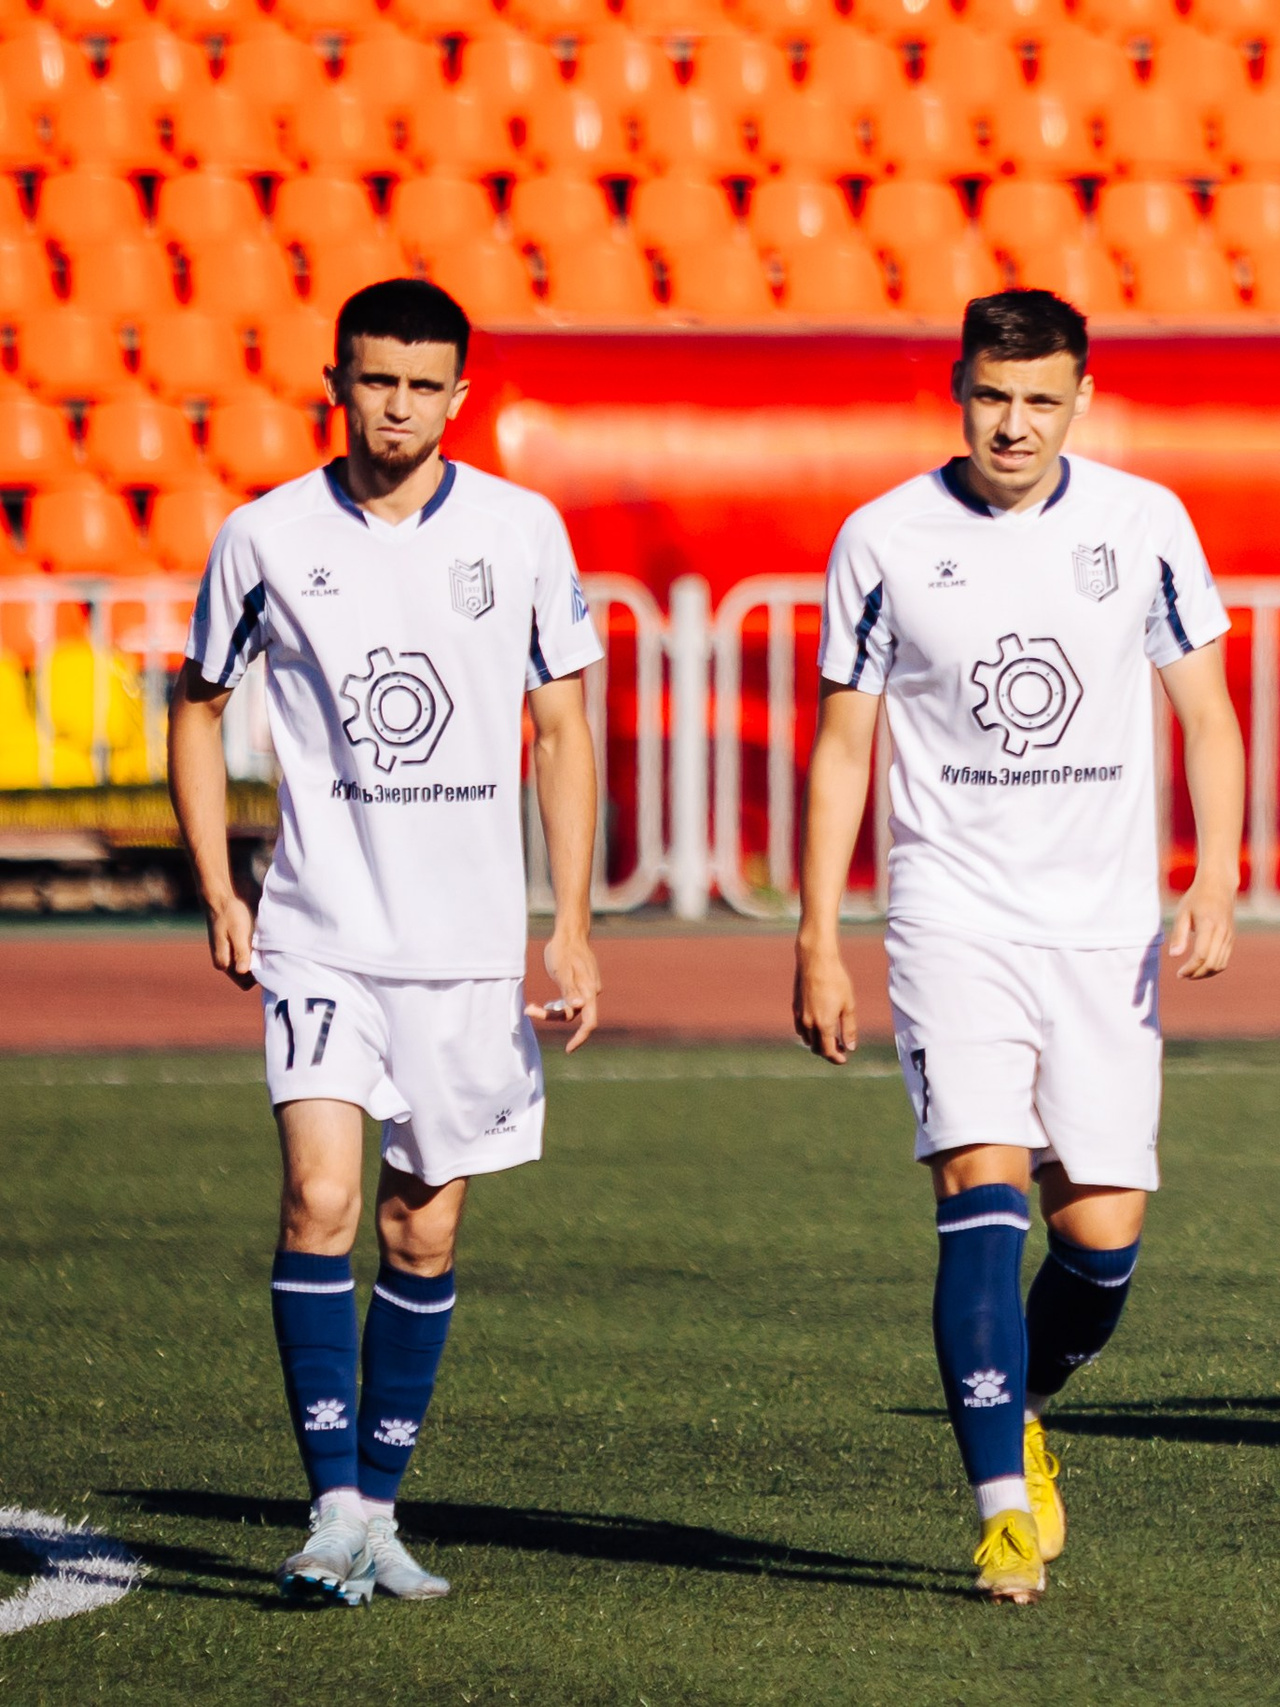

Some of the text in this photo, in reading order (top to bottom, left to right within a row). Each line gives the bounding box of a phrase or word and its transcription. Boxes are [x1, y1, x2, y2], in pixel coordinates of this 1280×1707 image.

[928, 579, 967, 589] KELME
[301, 588, 340, 597] KELME
[940, 764, 1123, 786] КубаньЭнергоРемонт
[274, 997, 336, 1072] 17
[484, 1125, 517, 1136] KELME
[963, 1392, 1011, 1408] KELME
[305, 1419, 347, 1430] KELME
